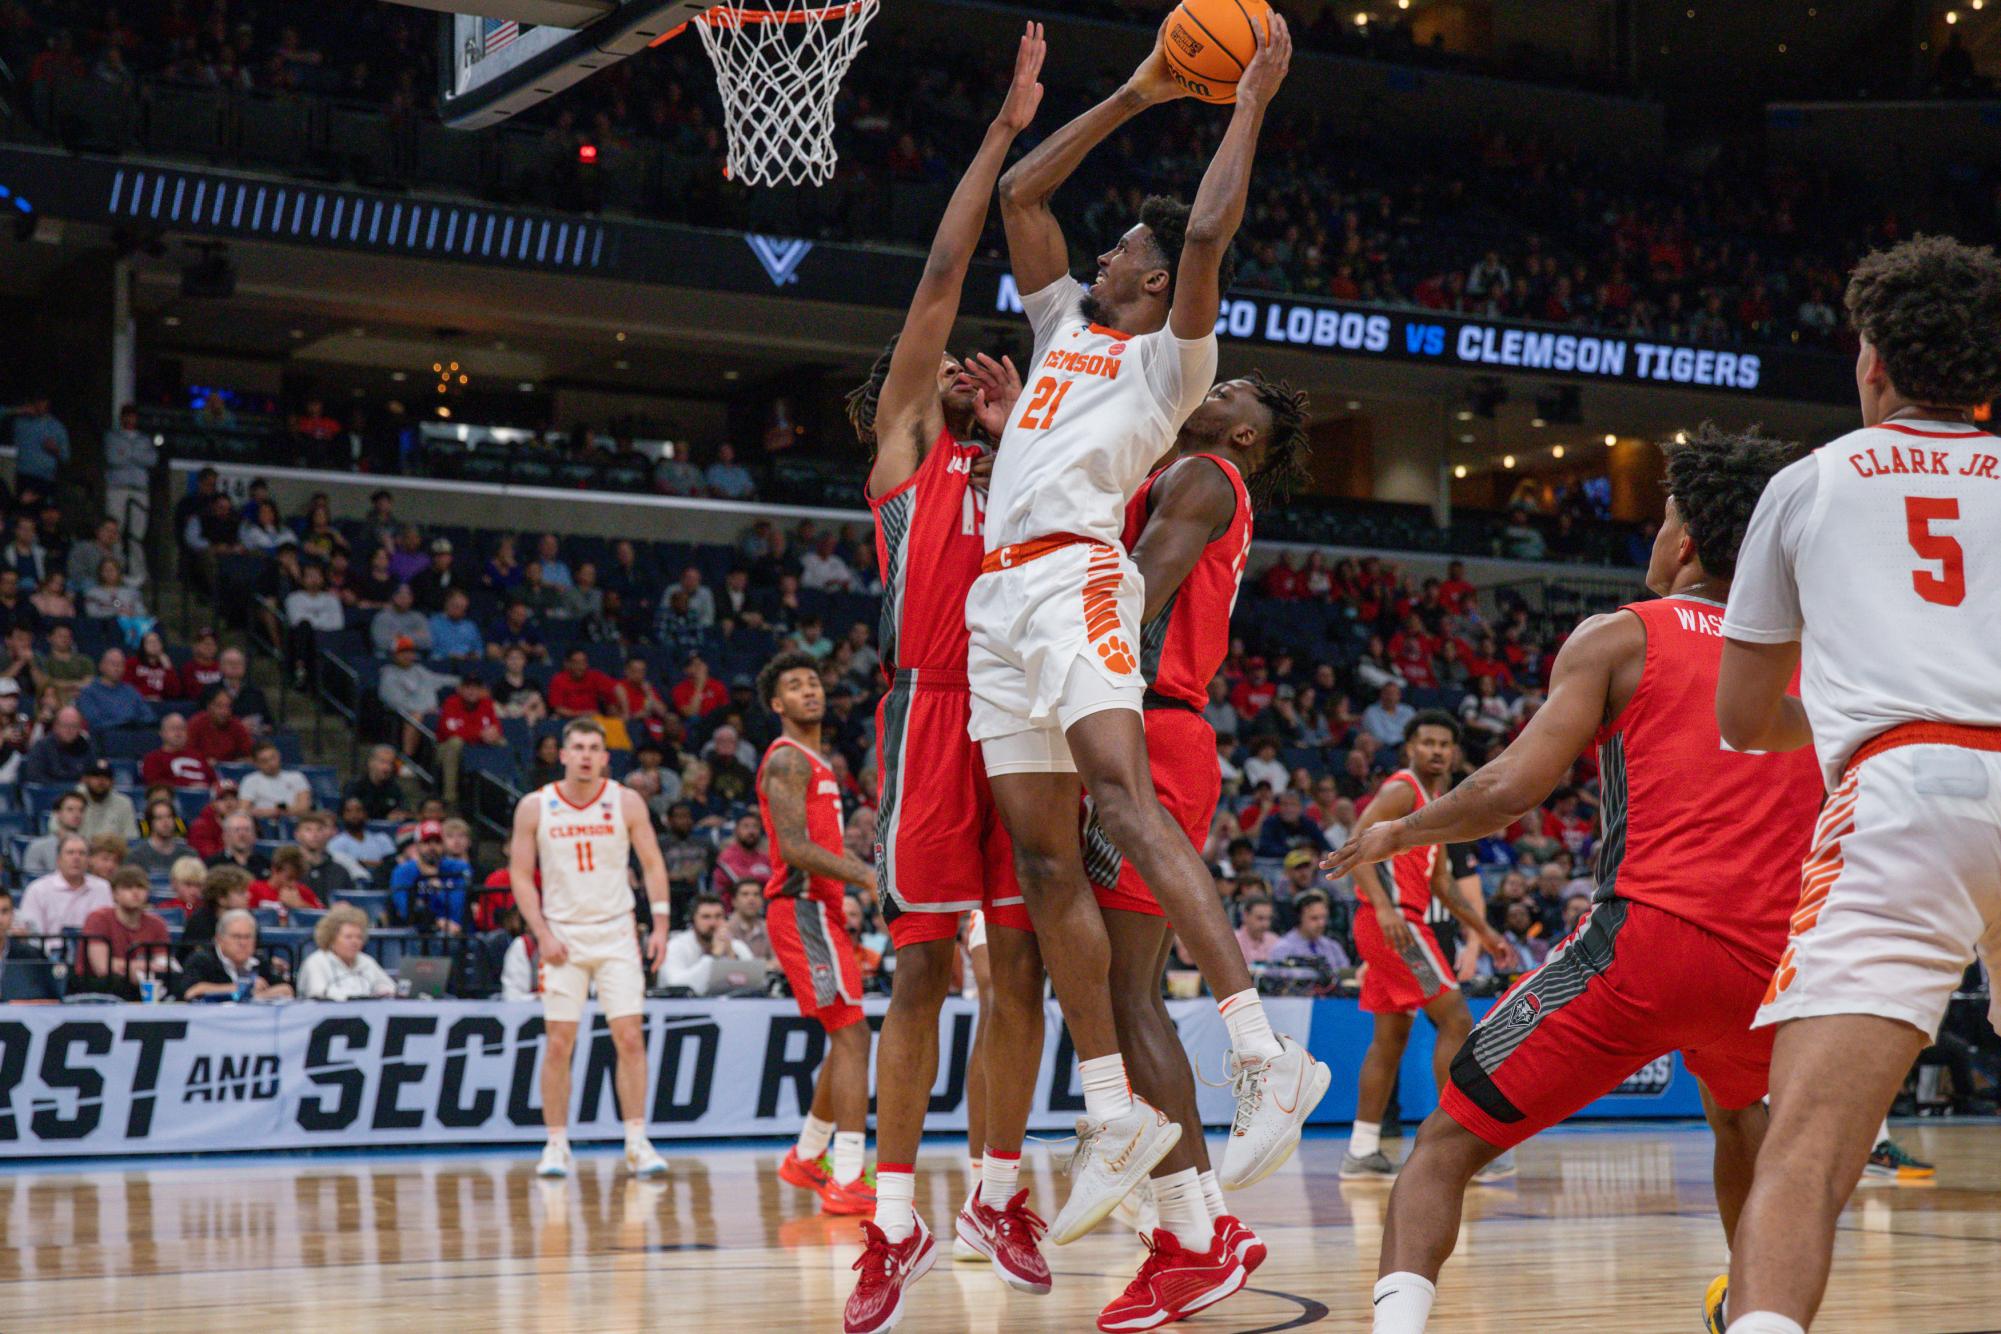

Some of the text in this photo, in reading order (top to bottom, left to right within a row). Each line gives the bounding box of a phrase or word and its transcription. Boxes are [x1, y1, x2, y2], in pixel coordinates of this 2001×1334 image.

[1264, 303, 1391, 353] LOBOS
[1405, 322, 1447, 356] VS
[1456, 324, 1627, 377] CLEMSON
[1634, 341, 1761, 390] TIGERS
[1017, 376, 1074, 430] 21
[1849, 445, 2001, 480] CLARK JR.
[1000, 546, 1012, 568] C
[1904, 495, 1967, 608] 5
[548, 824, 615, 839] CLEMSON
[576, 841, 595, 873] 11
[183, 1055, 281, 1103] AND
